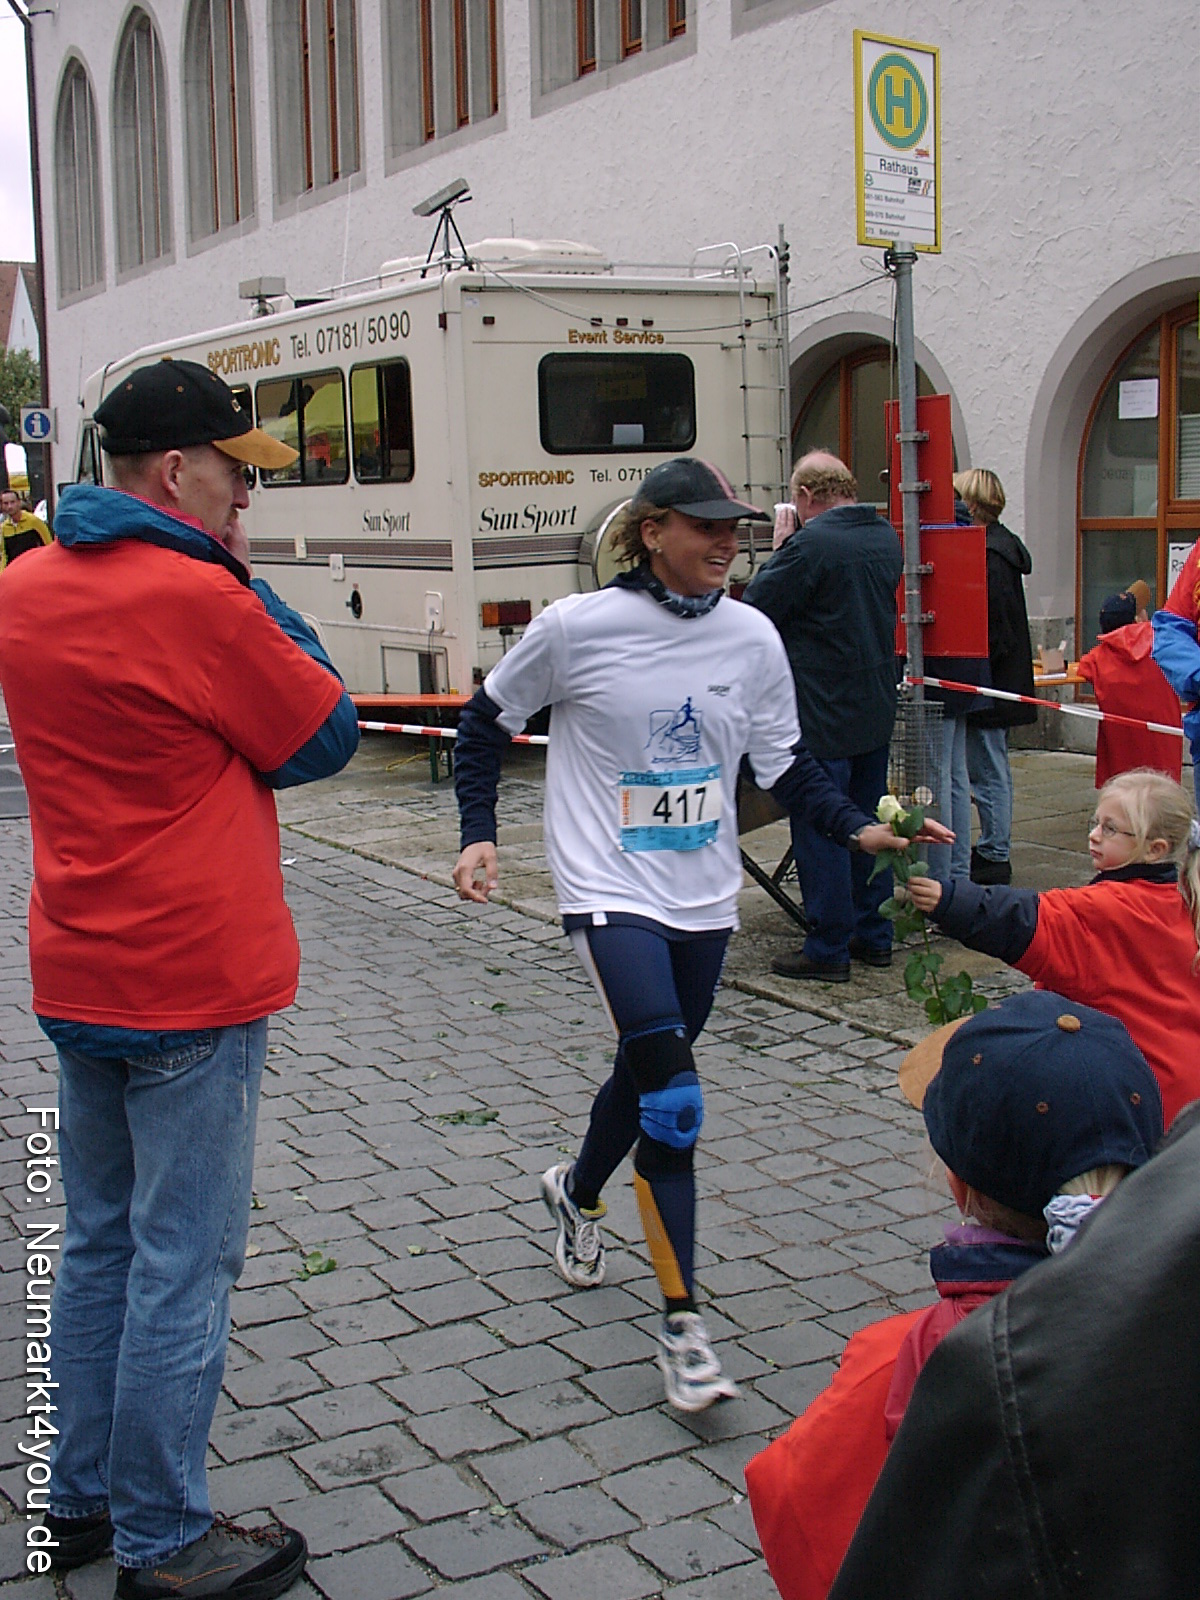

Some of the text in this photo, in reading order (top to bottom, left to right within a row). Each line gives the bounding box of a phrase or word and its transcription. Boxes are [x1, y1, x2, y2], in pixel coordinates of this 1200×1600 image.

[885, 74, 913, 129] H
[879, 158, 919, 177] Rathaus
[207, 310, 411, 375] SPORTRONIC Tel. 07181/5090
[568, 329, 665, 344] Event Service
[478, 470, 575, 489] SPORTRONIC
[589, 469, 612, 482] Tel.
[362, 508, 411, 537] Sun Sport
[478, 503, 577, 534] Sun Sport
[653, 786, 707, 824] 417
